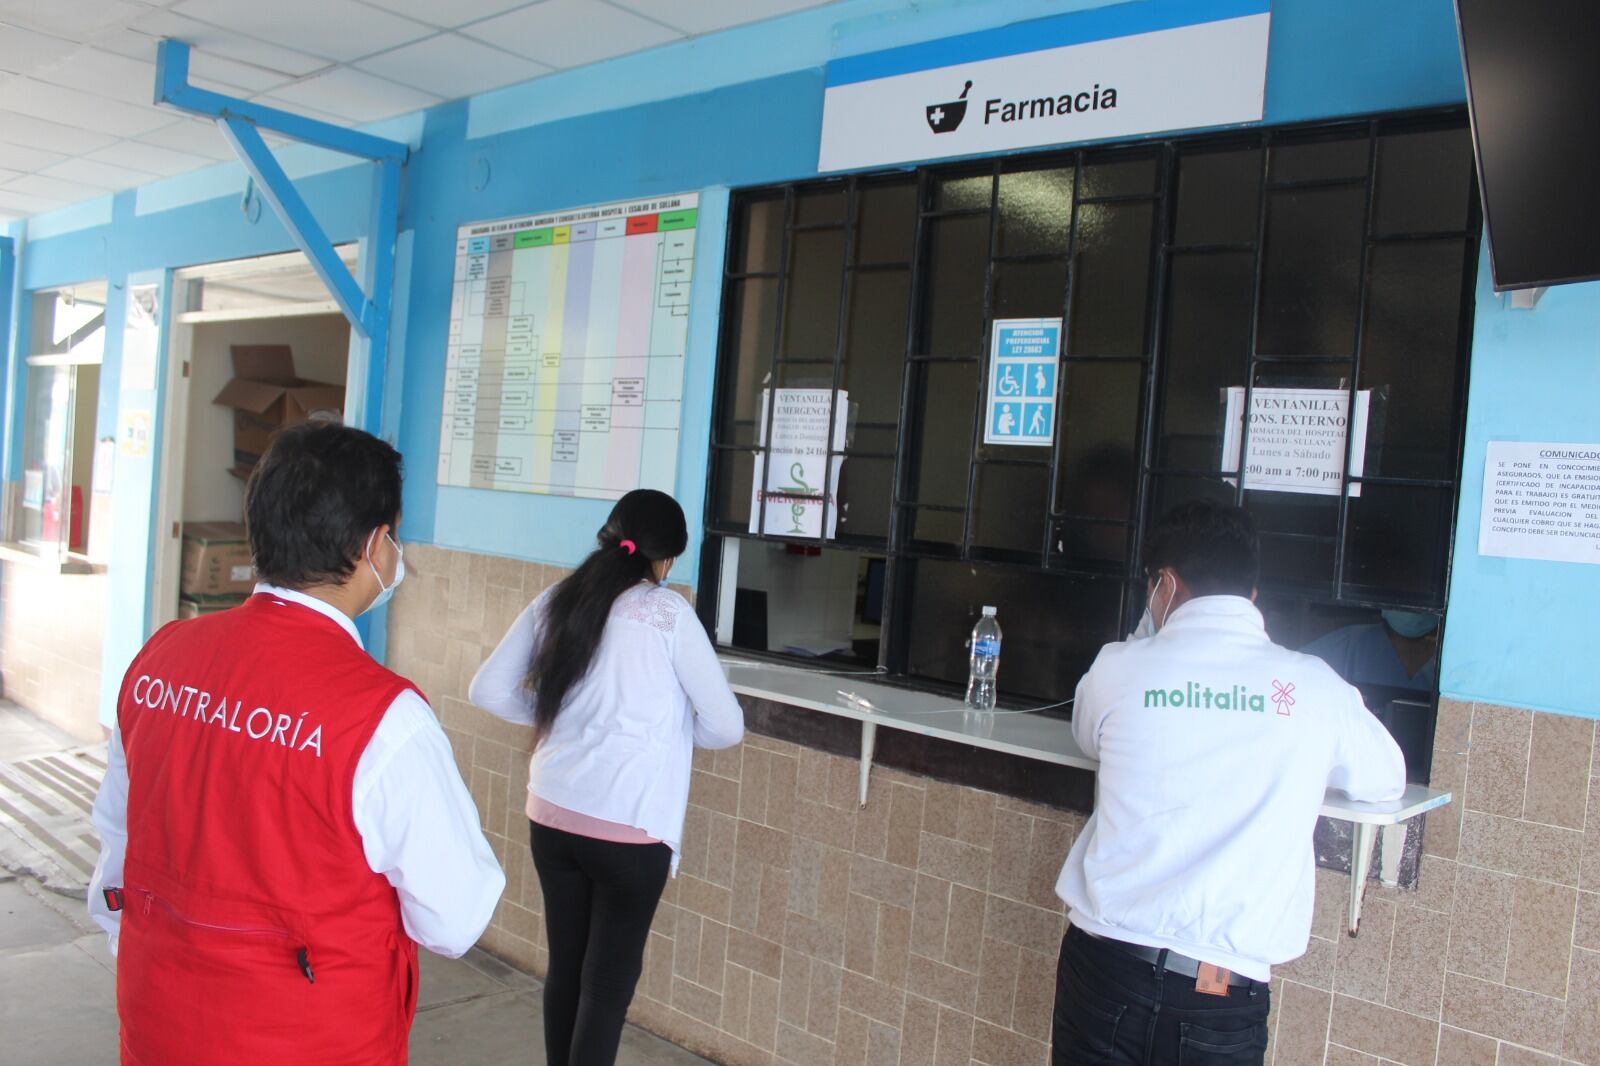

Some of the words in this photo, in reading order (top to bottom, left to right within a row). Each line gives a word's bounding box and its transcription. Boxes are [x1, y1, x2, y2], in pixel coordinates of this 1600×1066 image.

[984, 84, 1118, 124] Farmacia
[659, 200, 680, 208] SULLANA
[780, 394, 831, 404] VENTANILLA
[1255, 398, 1340, 411] VENTANILLA
[1247, 413, 1277, 424] ONS.
[1282, 415, 1346, 427] EXTERNO
[1252, 446, 1281, 457] Lunes
[1246, 465, 1262, 474] :00
[1265, 467, 1282, 476] am
[1285, 468, 1291, 476] a
[1296, 467, 1319, 479] 7:00
[1322, 471, 1341, 482] pm
[1529, 510, 1572, 518] EVALUACION
[1144, 680, 1264, 712] molitalia
[133, 674, 322, 758] CONTRALORÍA
